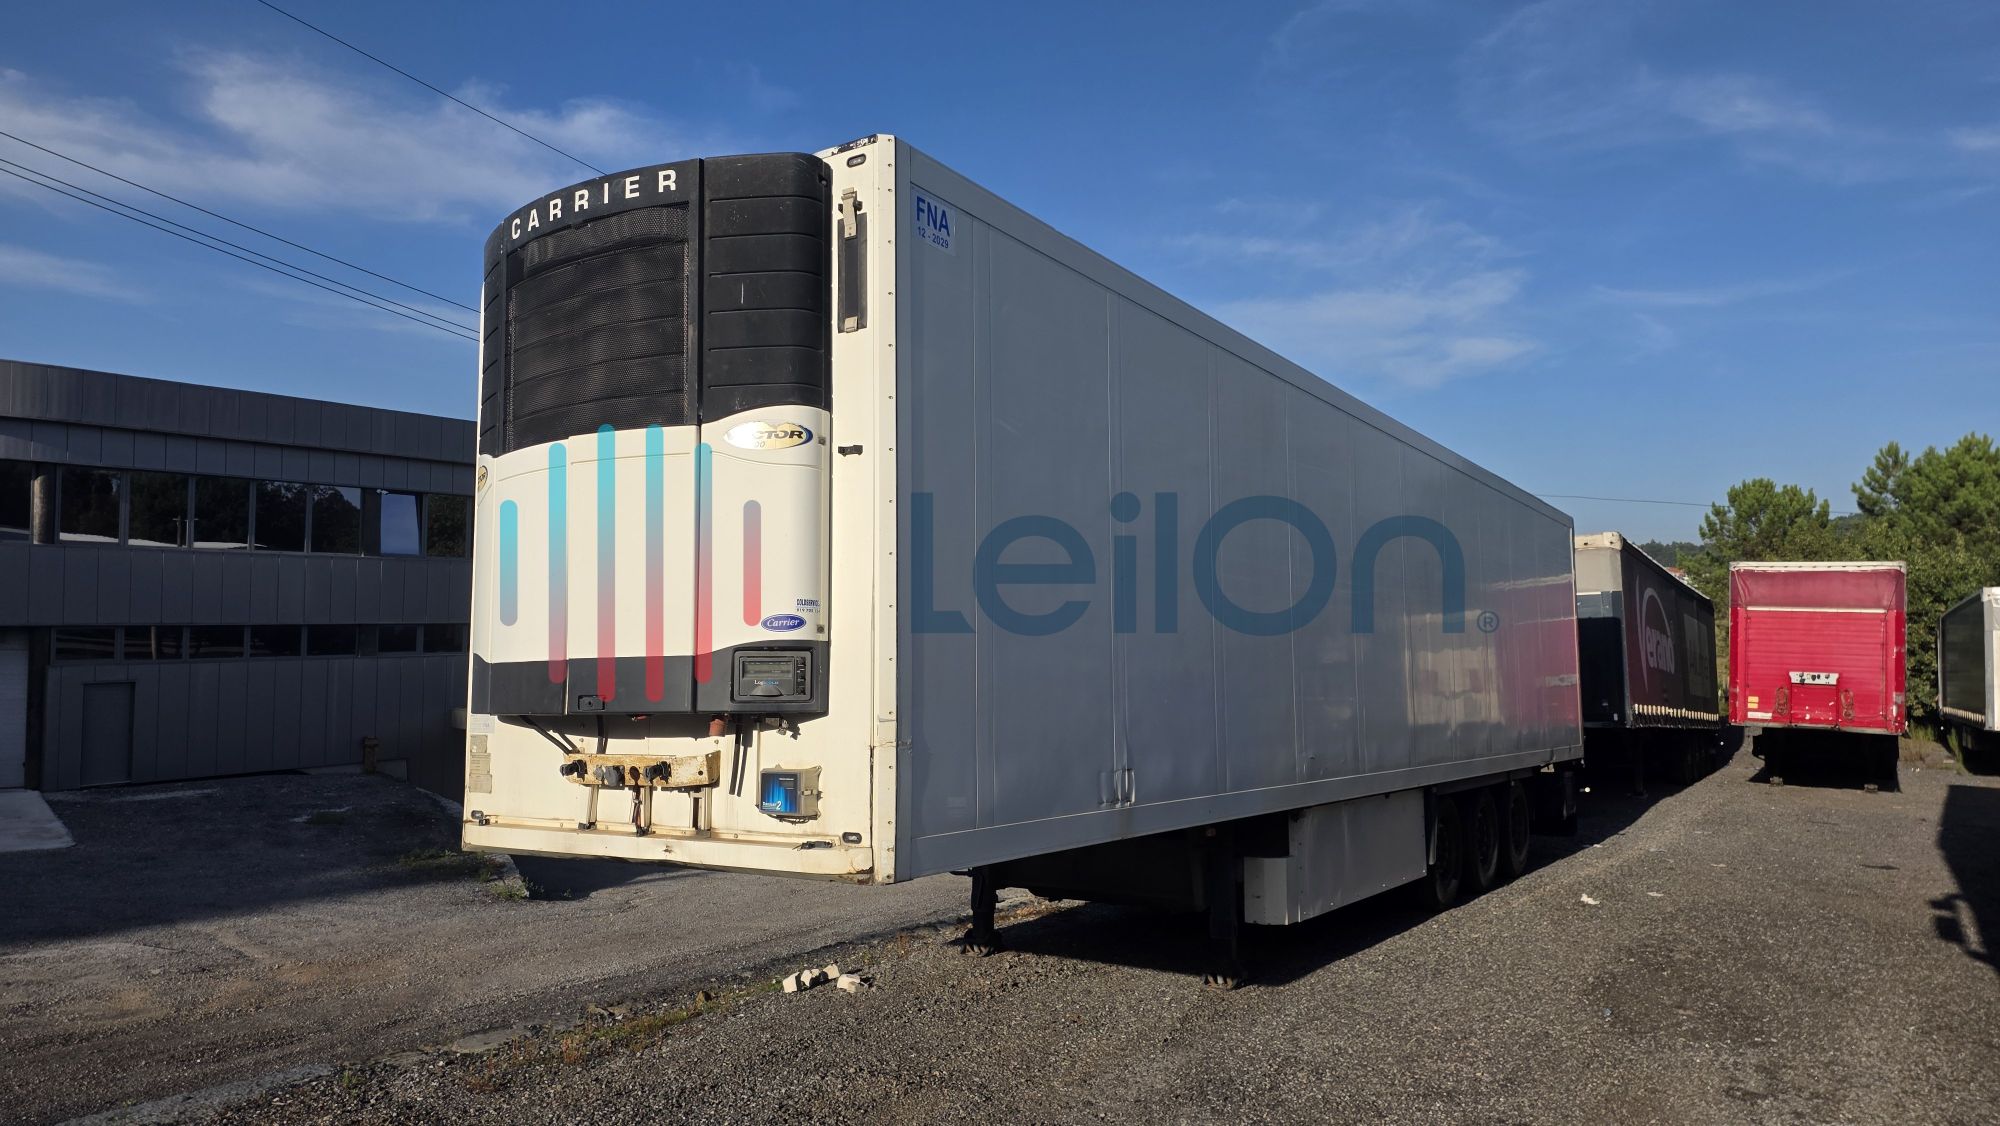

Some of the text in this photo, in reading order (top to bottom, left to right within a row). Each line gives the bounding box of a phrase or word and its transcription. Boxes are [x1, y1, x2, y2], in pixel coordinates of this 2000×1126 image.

[511, 169, 677, 240] CARRIER
[916, 195, 950, 237] FNA
[918, 226, 926, 239] 12
[767, 618, 800, 627] Carrier
